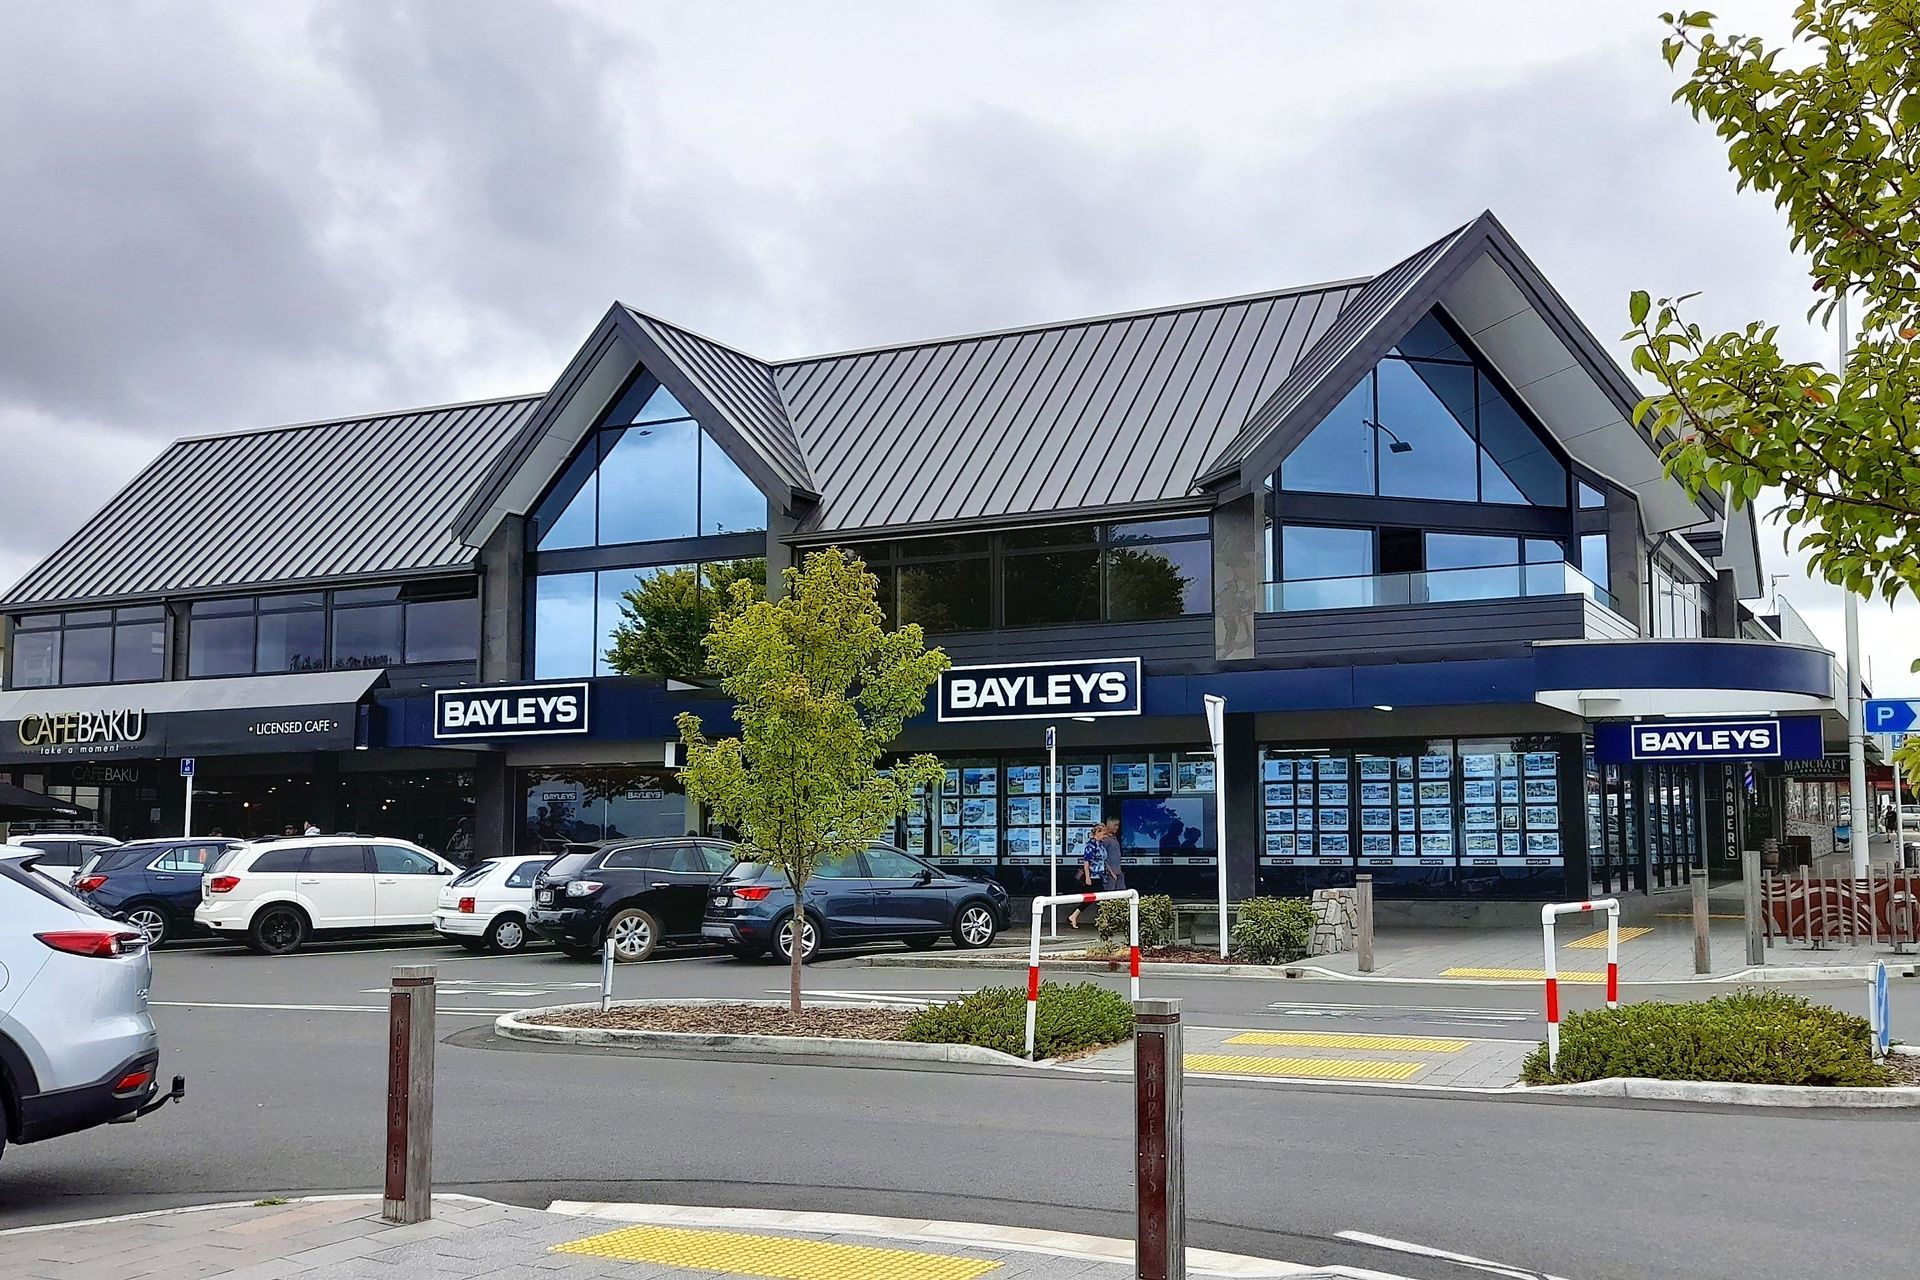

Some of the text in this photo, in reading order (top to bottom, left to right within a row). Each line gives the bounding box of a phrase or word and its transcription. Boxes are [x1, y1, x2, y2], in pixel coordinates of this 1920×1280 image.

[950, 671, 1127, 709] BAYLEYS
[444, 695, 578, 728] BAYLEYS
[1877, 706, 1895, 726] P
[256, 719, 331, 735] LICENSED CAFE
[40, 745, 62, 755] take
[79, 743, 120, 753] moment
[1640, 728, 1770, 752] BAYLEYS
[1783, 758, 1847, 773] MANCRAFT
[543, 792, 576, 800] BAYLEYS
[627, 791, 661, 799] BAYLEYS
[1724, 764, 1736, 858] BARBERS
